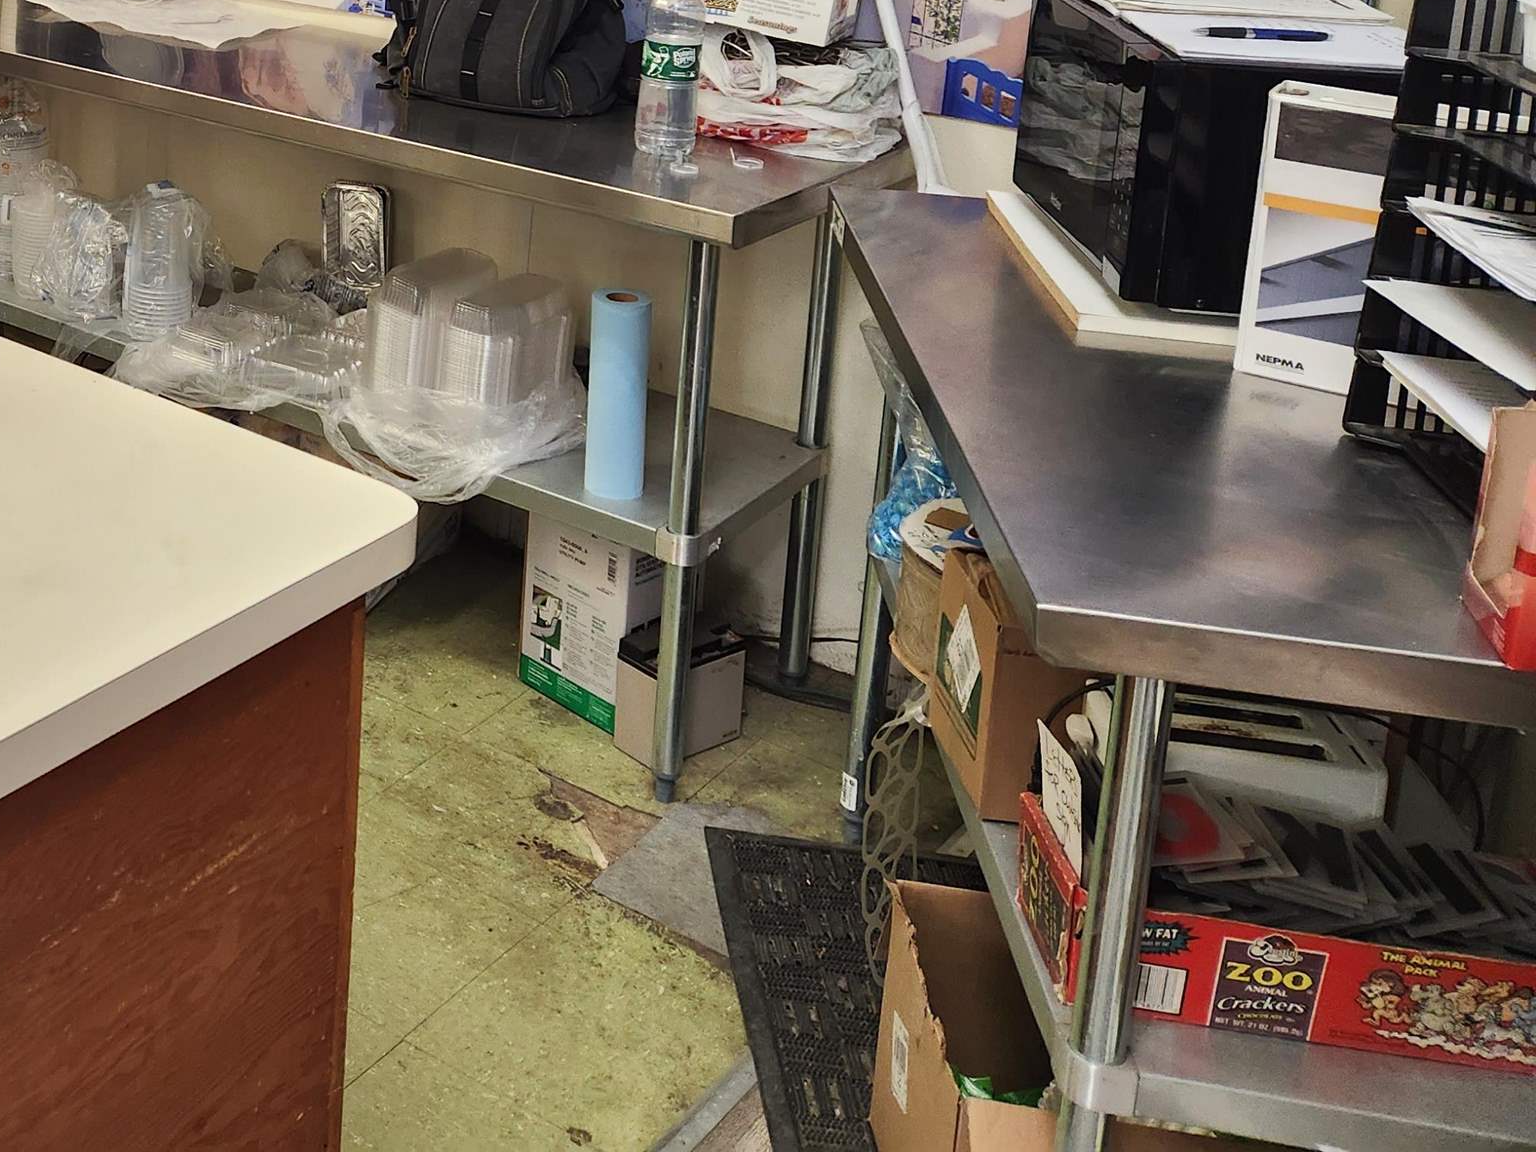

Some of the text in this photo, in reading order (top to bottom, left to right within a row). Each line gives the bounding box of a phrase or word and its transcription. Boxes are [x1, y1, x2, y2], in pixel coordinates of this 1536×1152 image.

[1255, 352, 1305, 372] NEPMA
[1155, 928, 1179, 940] FAT
[1381, 951, 1467, 971] THE ANIMAL
[1225, 961, 1313, 991] ZOO
[1404, 964, 1441, 977] PACK
[1245, 985, 1289, 998] ANIMAL
[1217, 996, 1307, 1014] Crackers
